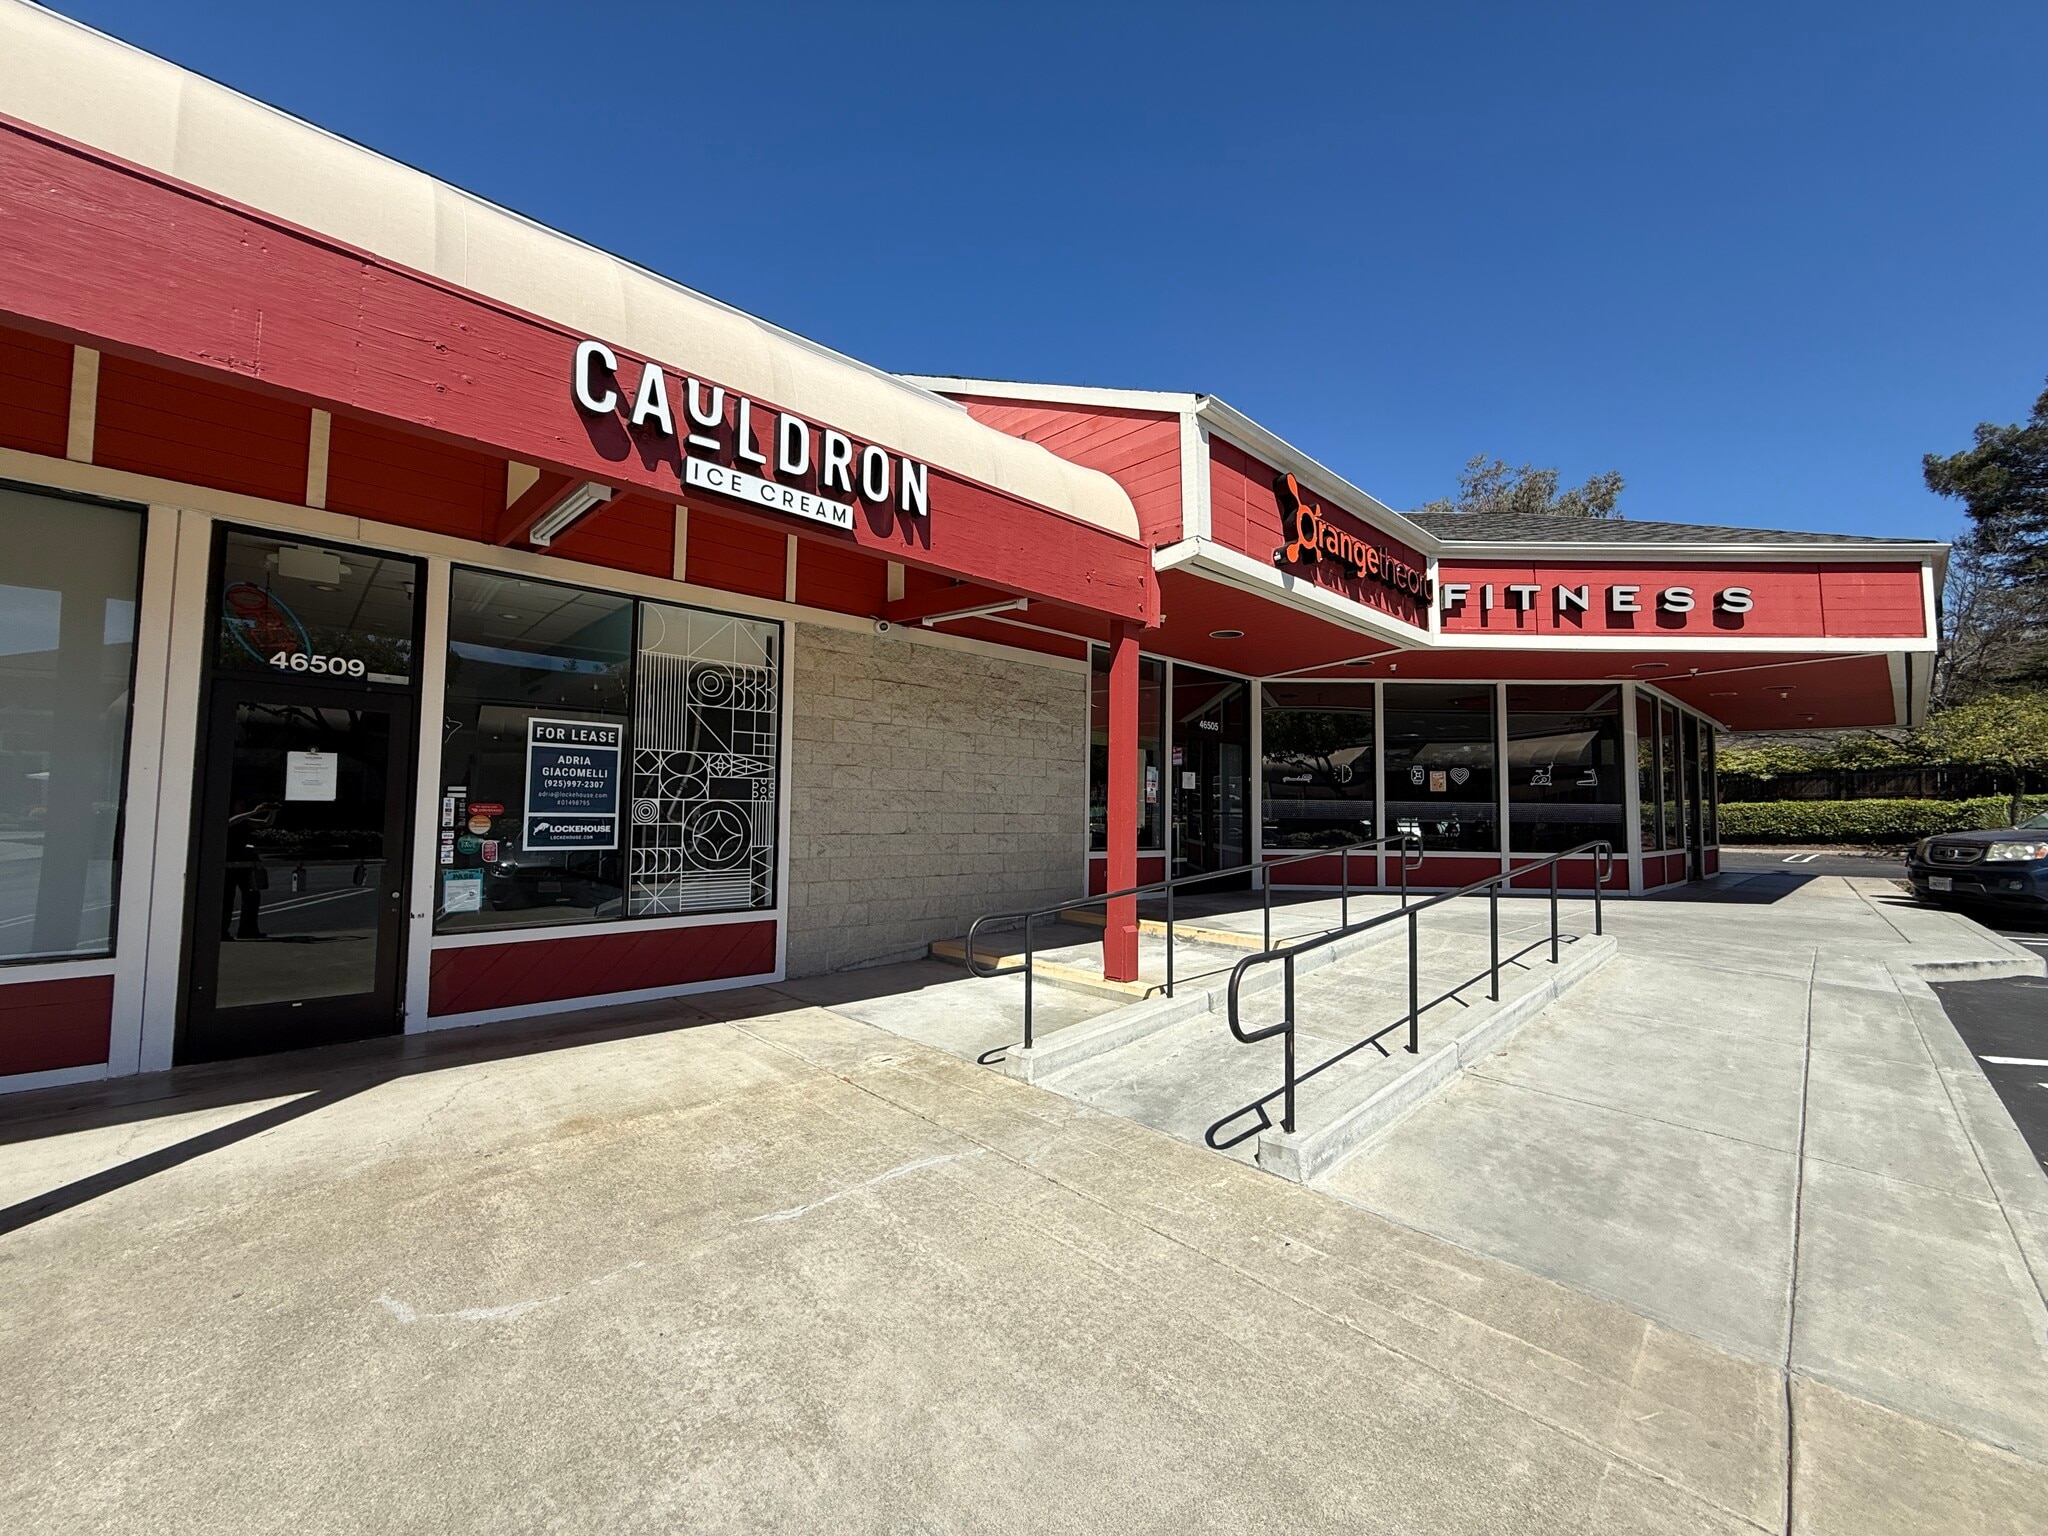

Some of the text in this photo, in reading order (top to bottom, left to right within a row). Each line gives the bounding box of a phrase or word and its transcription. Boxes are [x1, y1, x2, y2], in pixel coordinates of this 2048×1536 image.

[575, 338, 929, 517] CAULDRON
[693, 463, 847, 525] ICE CREAM
[1443, 583, 1755, 614] FITNESS
[269, 651, 366, 678] 46509
[1199, 720, 1219, 732] 46505
[536, 726, 616, 743] FOR LEASE
[557, 755, 592, 765] ADRIA
[542, 766, 608, 778] GIACOMELLI
[544, 779, 604, 789] (925)997-2307
[538, 790, 608, 799] adria@lockehouse.com
[550, 825, 611, 833] LOCKEHOUSE
